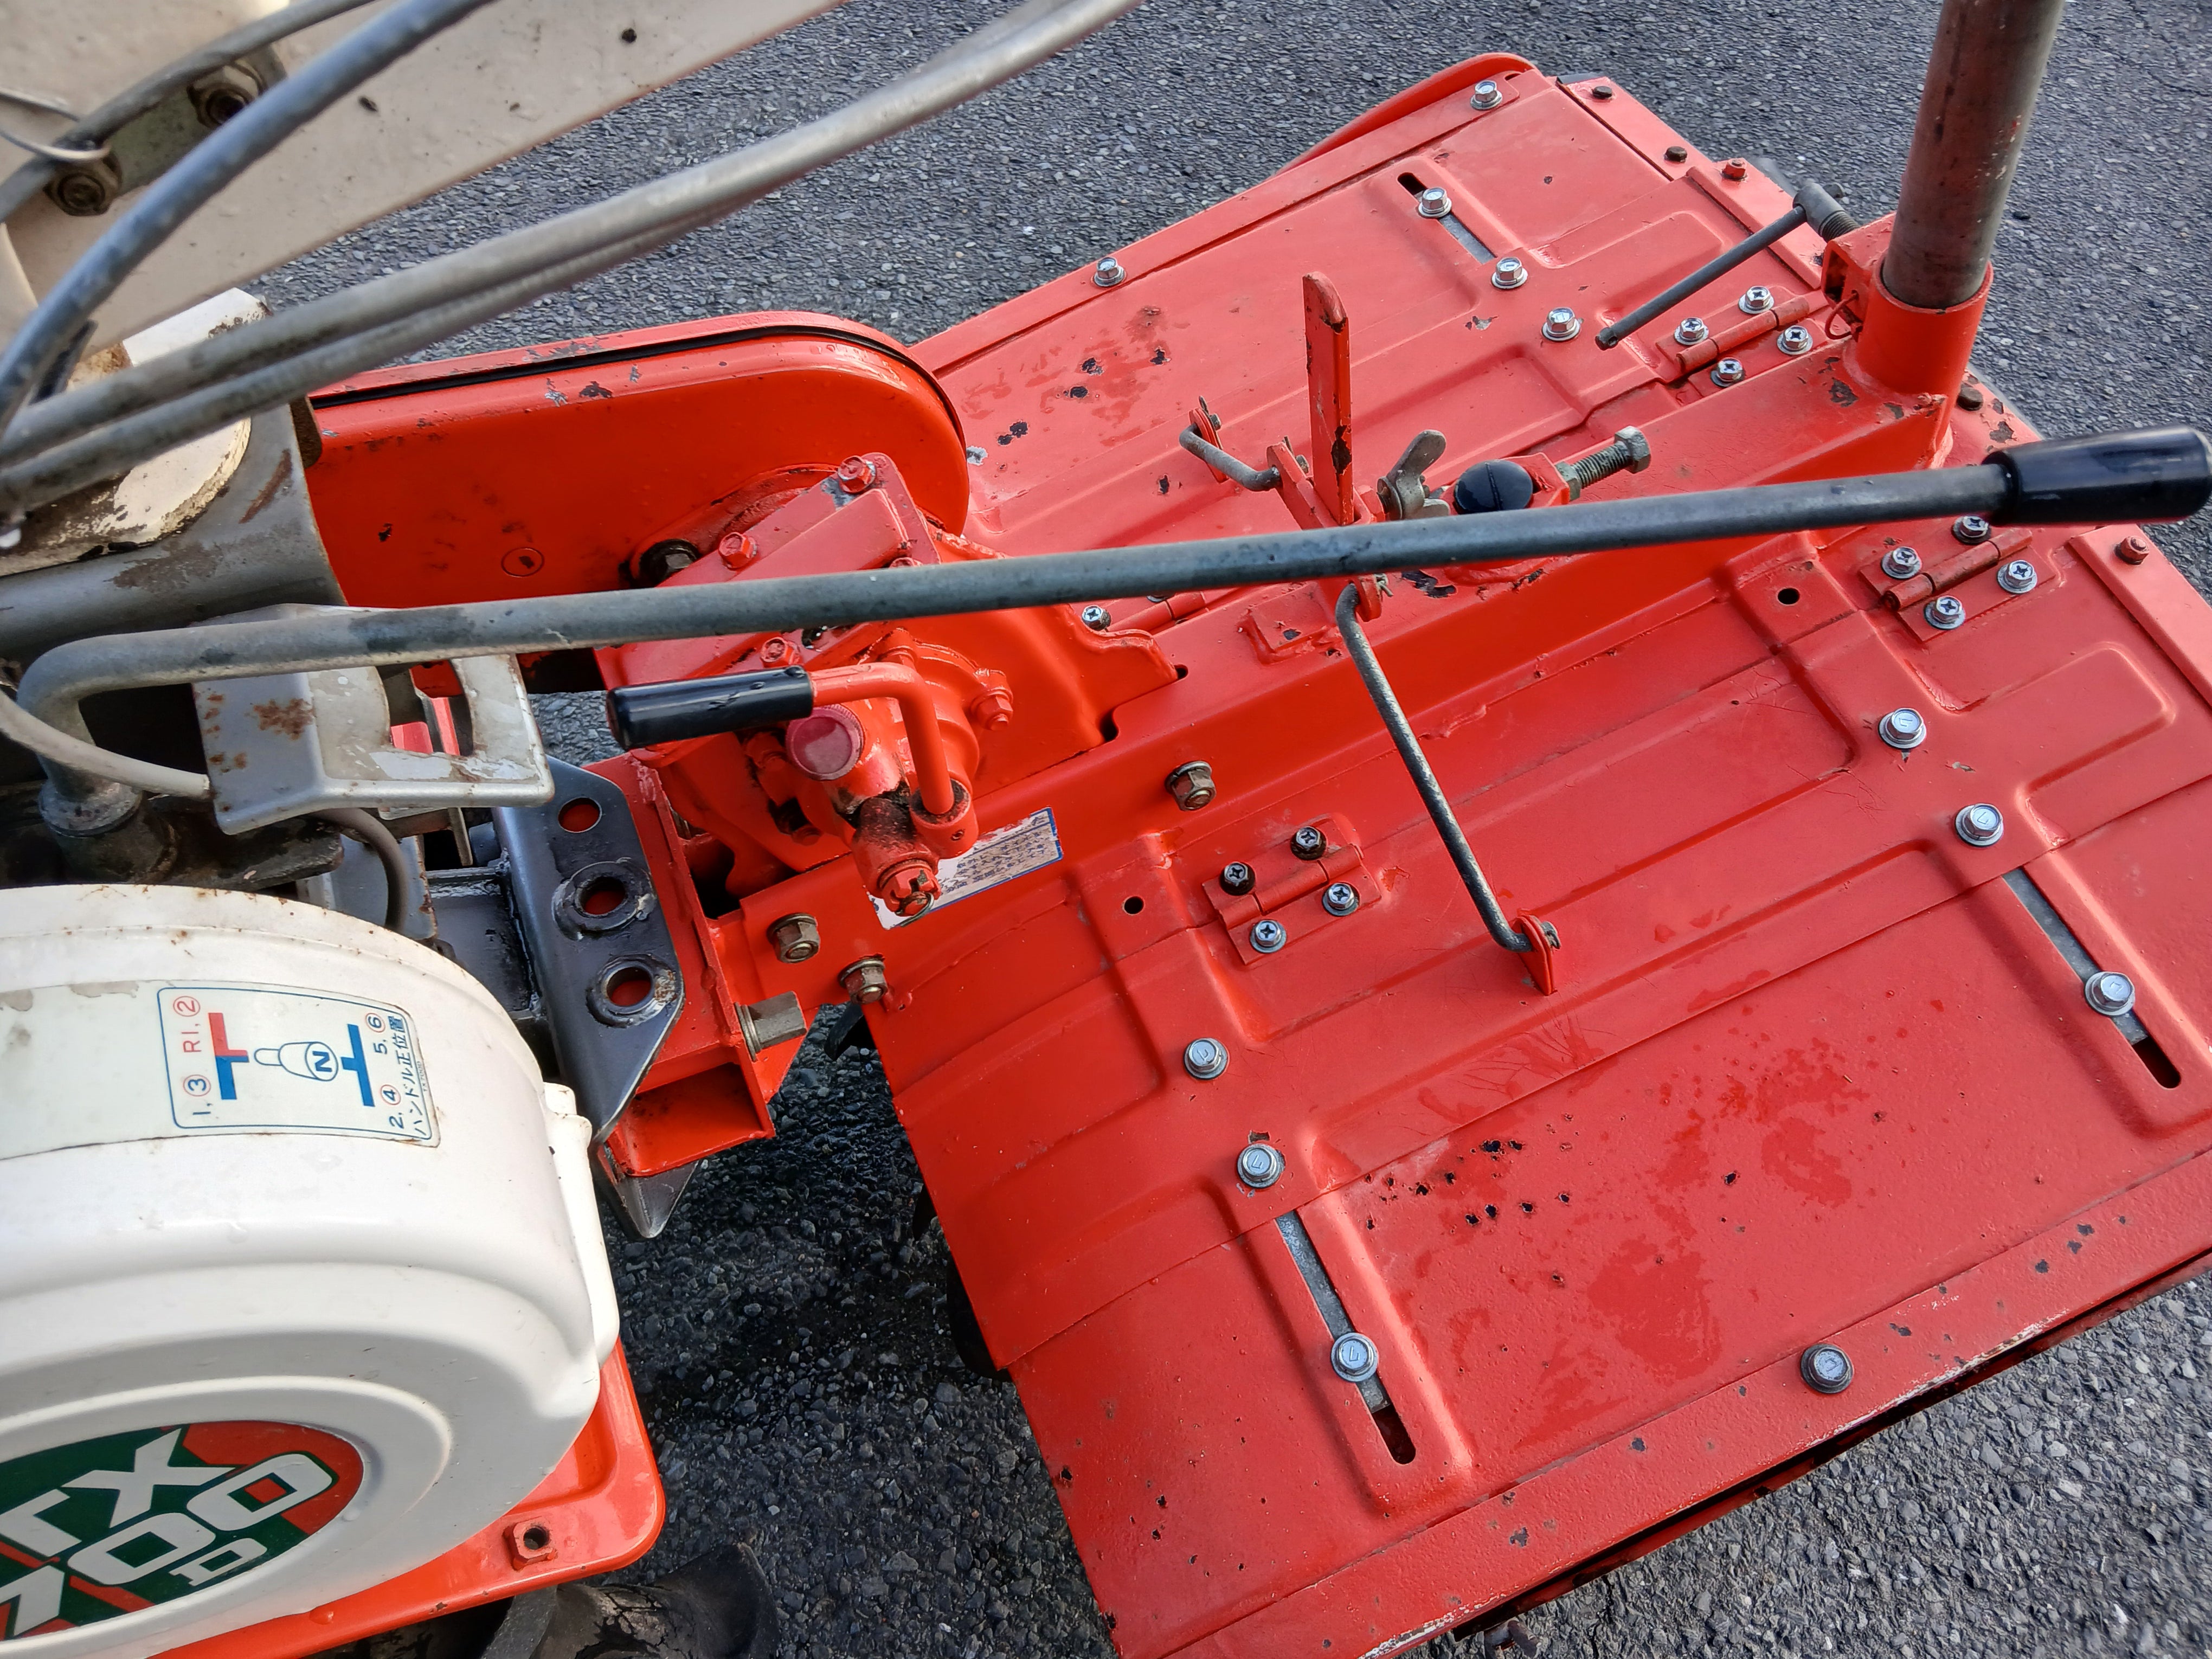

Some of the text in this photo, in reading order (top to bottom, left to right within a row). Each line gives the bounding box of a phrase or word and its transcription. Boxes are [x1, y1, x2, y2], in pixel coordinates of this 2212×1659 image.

[312, 1051, 332, 1072] N
[388, 1015, 427, 1136] ハンドル正位置
